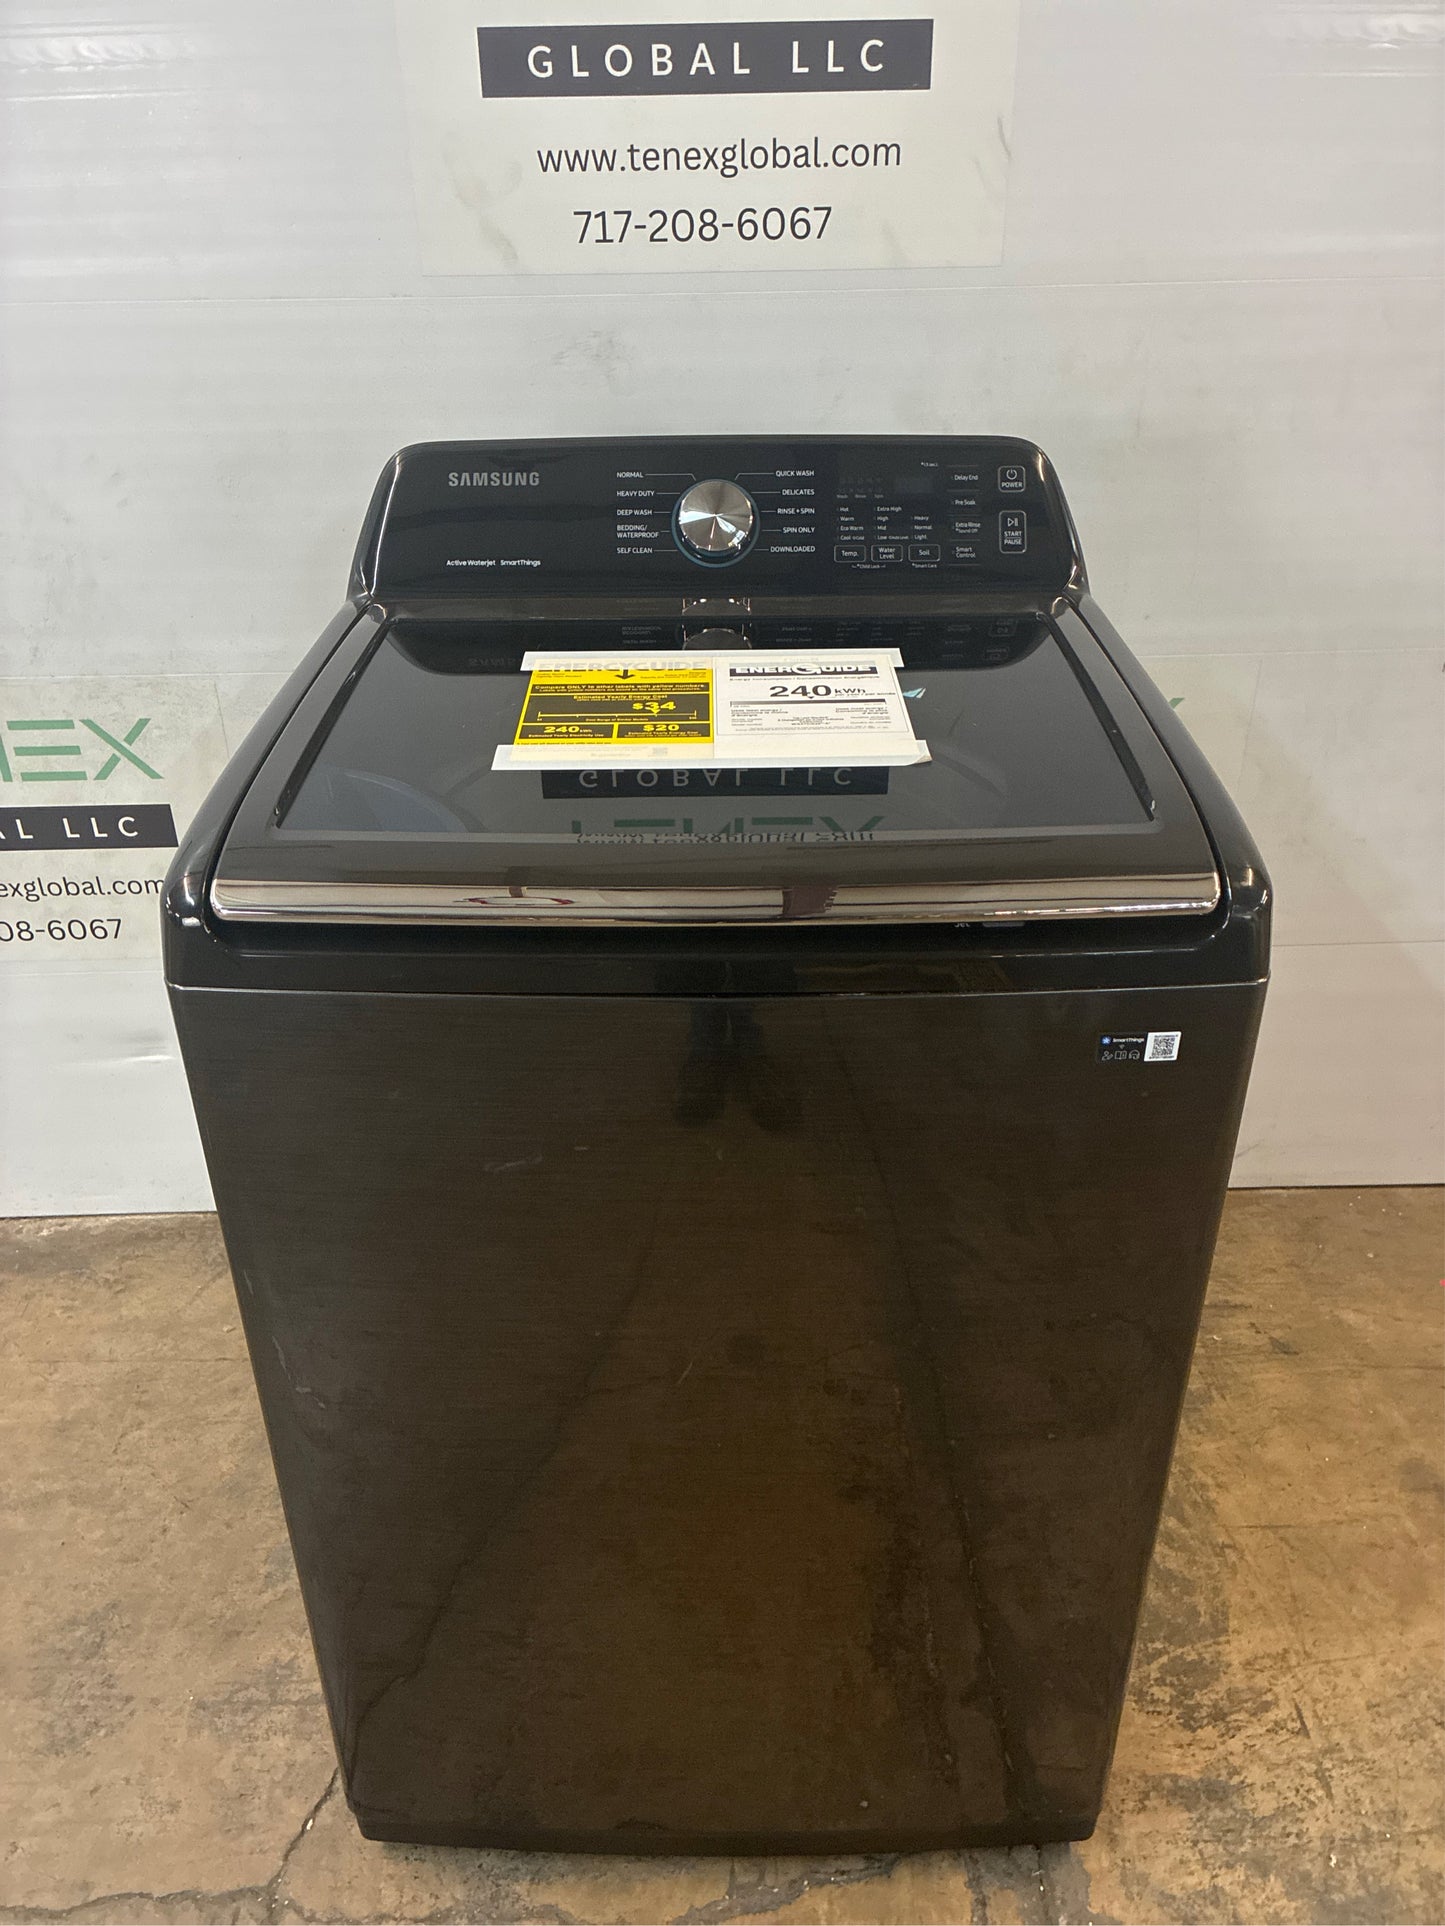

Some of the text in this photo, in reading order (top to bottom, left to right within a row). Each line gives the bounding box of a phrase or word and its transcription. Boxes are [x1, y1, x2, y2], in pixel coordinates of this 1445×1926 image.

[526, 39, 885, 79] GLOBAL LLC
[536, 137, 902, 179] www.tenexglobal.com
[572, 206, 833, 244] 717-208-6067
[616, 471, 644, 479] NORMAL
[775, 470, 795, 478] QUICK
[954, 474, 968, 482] Delay
[448, 471, 541, 487] SAMSUNG
[616, 524, 648, 532] BEDDING/
[769, 545, 816, 553] DOWNLOADED
[446, 559, 467, 567] Active
[500, 558, 541, 567] SmartThings
[769, 684, 832, 698] 240
[632, 701, 677, 710] $34
[543, 726, 580, 734] 240
[642, 724, 680, 732] $20
[62, 816, 139, 839] LLC
[0, 918, 122, 942] 08-6067
